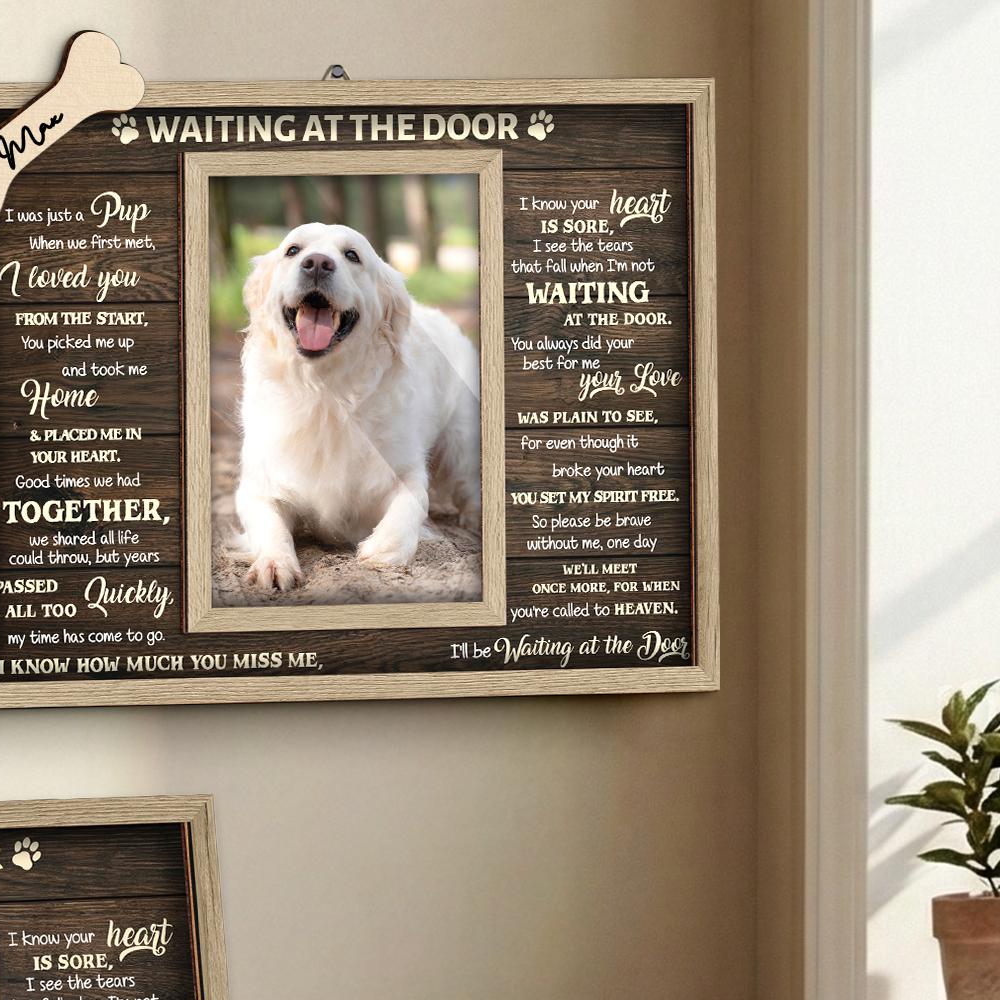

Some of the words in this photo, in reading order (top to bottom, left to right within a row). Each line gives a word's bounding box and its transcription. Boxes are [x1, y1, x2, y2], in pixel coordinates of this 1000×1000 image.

[146, 115, 295, 143] WAITING
[302, 115, 343, 141] AT
[350, 114, 416, 141] THE
[423, 113, 519, 140] DOOR
[5, 208, 14, 222] I
[17, 212, 43, 222] was
[47, 208, 72, 226] just
[75, 211, 84, 221] a
[91, 191, 151, 233] Pup
[541, 219, 558, 233] IS
[563, 219, 614, 235] SORE,
[511, 259, 542, 273] that
[545, 258, 567, 273] fall
[570, 258, 603, 273] when
[607, 259, 627, 272] I'm
[631, 258, 655, 272] not
[0, 261, 21, 297] I
[28, 264, 91, 288] loved
[96, 269, 140, 302] you
[526, 281, 650, 304] WAITING
[563, 313, 583, 326] AT
[587, 313, 619, 326] THE
[624, 312, 672, 325] DOOR.
[21, 336, 44, 349] You
[48, 334, 92, 353] picked
[96, 338, 114, 348] me
[118, 338, 134, 352] up
[522, 356, 553, 370] best
[557, 355, 578, 369] for
[582, 359, 600, 369] me
[21, 379, 99, 420] Home
[517, 411, 548, 424] WAS
[553, 411, 598, 423] PLAIN
[602, 410, 622, 423] TO
[626, 410, 658, 424] SEE,
[30, 451, 68, 463] YOUR
[71, 450, 121, 463] HEART.
[552, 463, 591, 477] broke
[595, 466, 624, 481] your
[627, 462, 665, 476] heart
[3, 499, 170, 525] TOGETHER,
[532, 515, 547, 528] So
[551, 513, 591, 532] please
[594, 513, 611, 527] be
[615, 512, 651, 527] brave
[9, 550, 44, 565] could
[47, 550, 91, 565] throw,
[95, 549, 120, 563] but
[123, 552, 160, 567] years
[563, 563, 598, 575] WE'LL
[602, 563, 637, 574] MEET
[5, 604, 36, 618] ALL
[41, 604, 77, 617] TOO
[84, 576, 174, 619] Quickly,
[510, 606, 549, 622] you're
[552, 602, 590, 617] called
[593, 603, 610, 616] to
[615, 602, 678, 615] HEAVEN.
[450, 642, 468, 658] I'll
[472, 642, 491, 658] be
[494, 634, 574, 667] Waiting
[579, 636, 600, 654] at
[603, 635, 633, 654] the
[637, 631, 690, 662] Door
[11, 658, 71, 674] KNOW
[77, 656, 120, 673] HOW
[127, 655, 184, 671] MUCH
[190, 654, 227, 670] YOU
[233, 652, 282, 668] MISS
[288, 652, 323, 670] ME,
[8, 932, 18, 946] I
[22, 930, 60, 946] know
[64, 932, 95, 949] your
[107, 918, 173, 962] heart
[26, 977, 35, 991] I
[40, 979, 63, 991] see
[67, 974, 92, 990] the
[96, 974, 135, 989] tears
